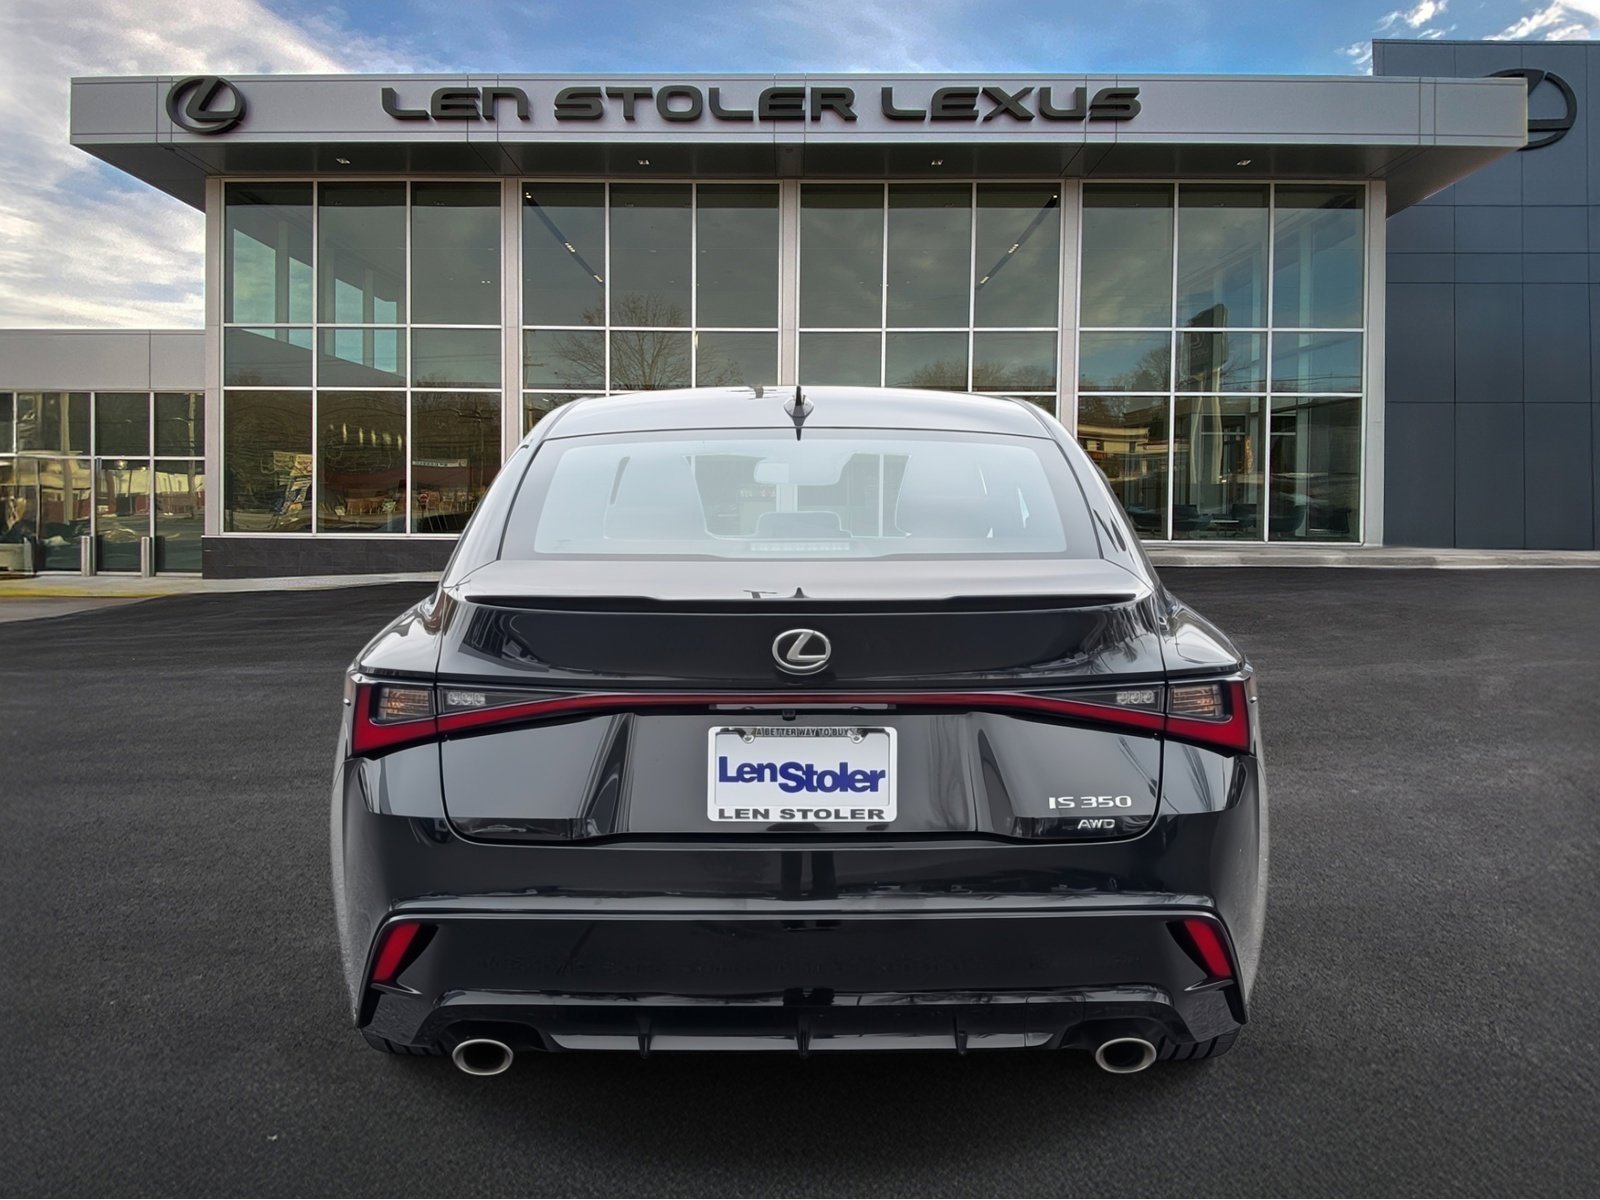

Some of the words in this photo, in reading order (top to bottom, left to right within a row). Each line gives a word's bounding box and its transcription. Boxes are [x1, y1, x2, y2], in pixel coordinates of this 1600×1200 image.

[381, 86, 530, 121] LEN
[553, 84, 857, 121] STOLER
[880, 86, 1142, 121] LEXUS
[764, 727, 797, 736] BETTER
[798, 727, 817, 736] WAY
[819, 727, 831, 736] TO
[1048, 796, 1076, 810] IS
[1080, 795, 1132, 809] 350
[718, 808, 770, 820] LEN
[779, 808, 886, 820] STOLER
[1077, 819, 1116, 830] AWD
